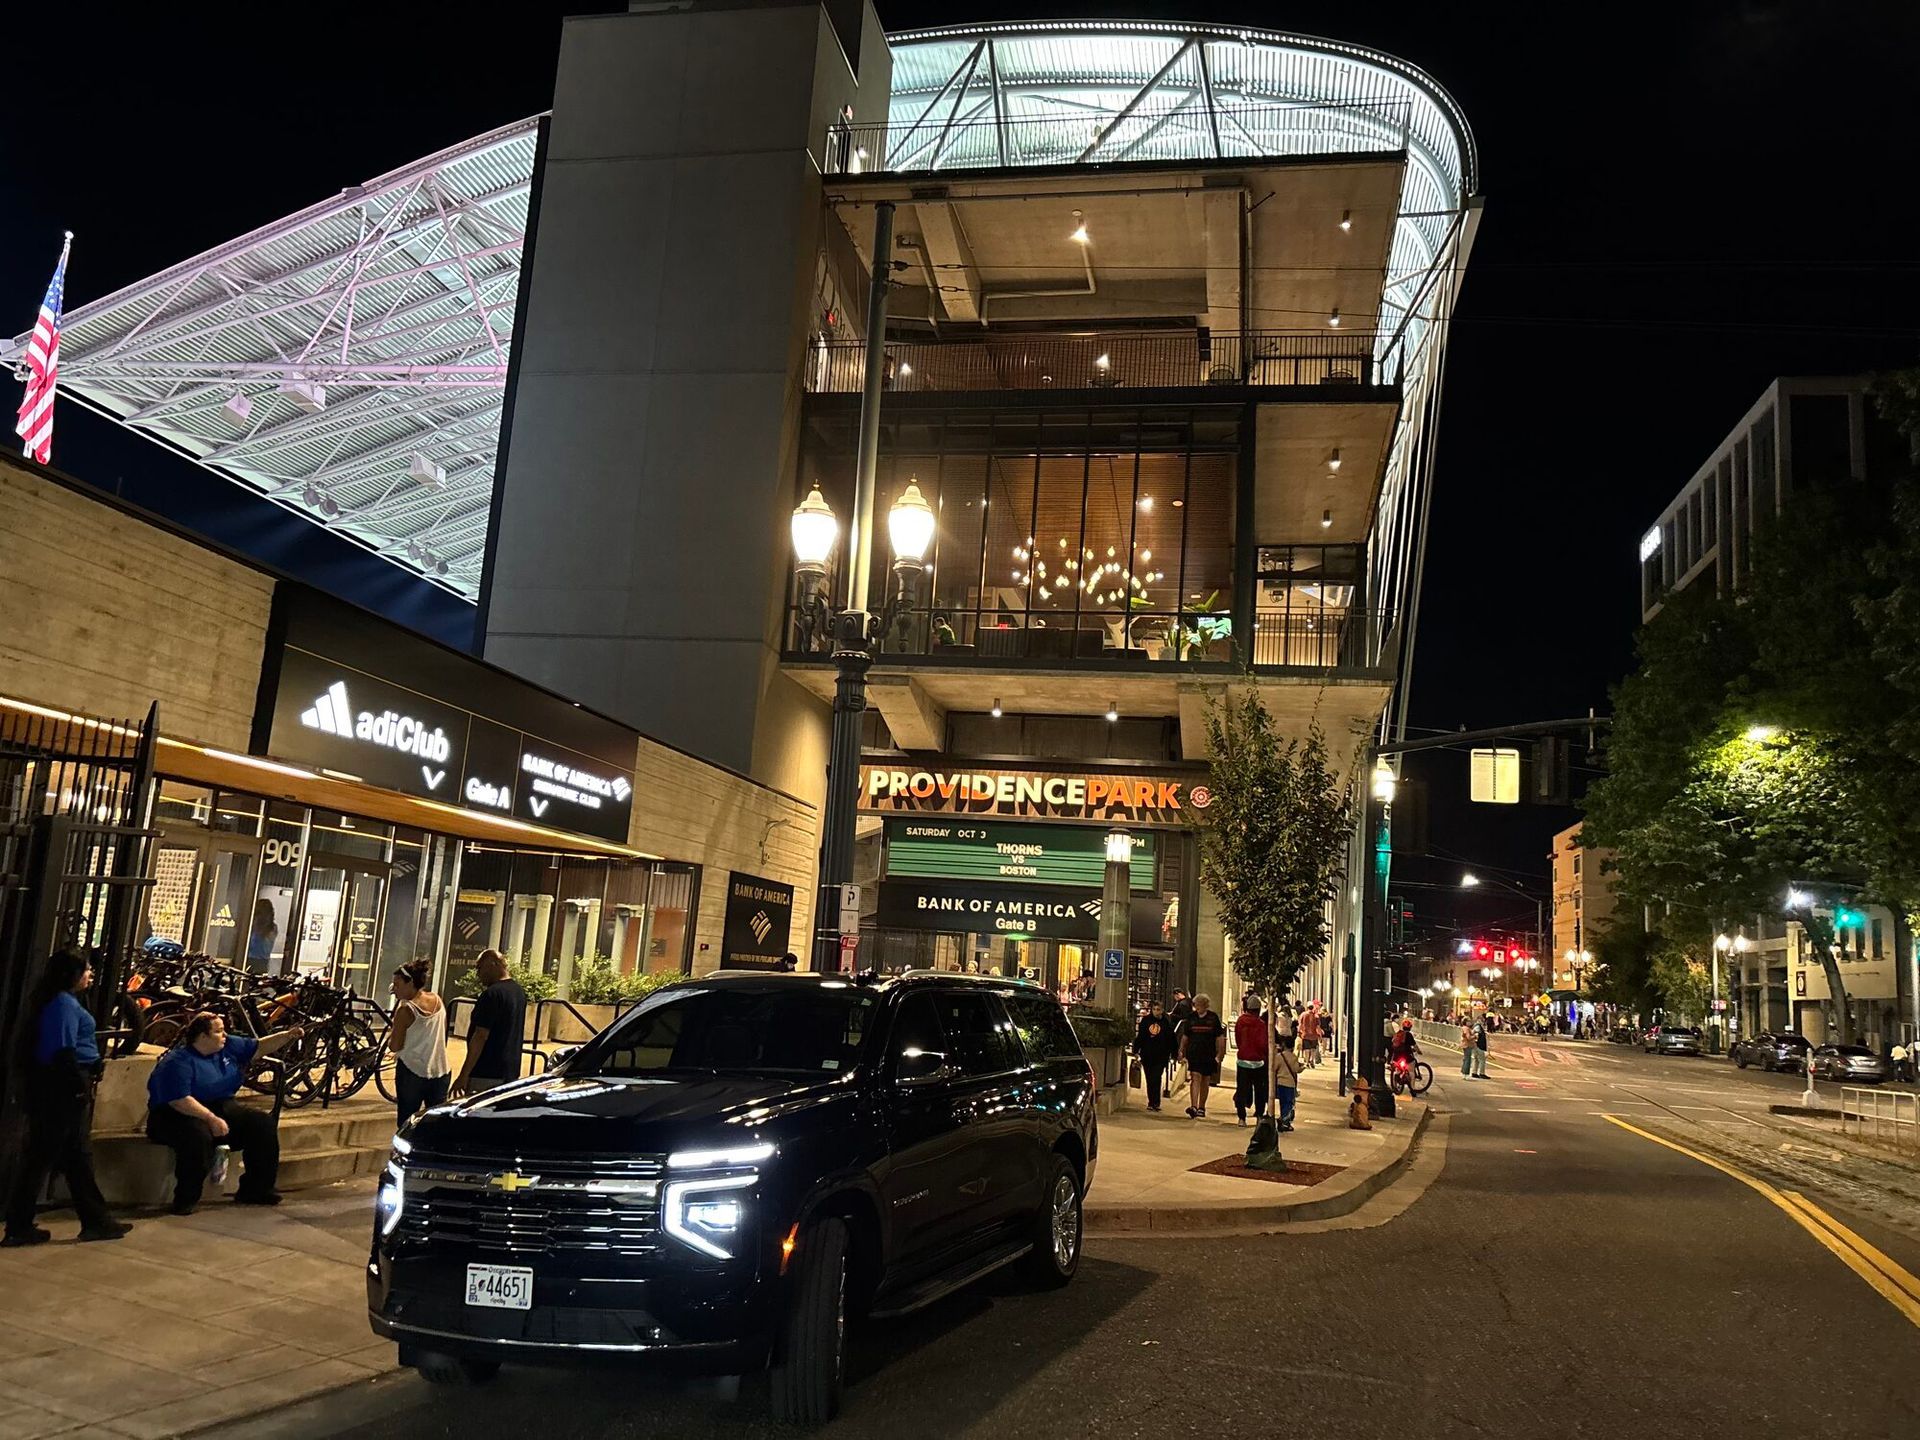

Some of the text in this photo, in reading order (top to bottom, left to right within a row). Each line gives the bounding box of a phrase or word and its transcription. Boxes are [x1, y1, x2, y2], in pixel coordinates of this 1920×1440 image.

[355, 710, 449, 763] adiClub
[521, 753, 612, 797] BANK OF AMERICA
[466, 777, 511, 809] Gate A
[906, 827, 987, 840] SATURDAY OCT 3
[264, 838, 301, 869] 909
[996, 842, 1043, 857] THORNS
[1011, 855, 1025, 865] VS
[999, 865, 1037, 877] BOSTON
[735, 882, 790, 906] BANK OF AMERICA
[917, 896, 1076, 918] BANK OF AMERICA
[995, 917, 1036, 931] Gate B
[486, 1275, 527, 1299] 44651
